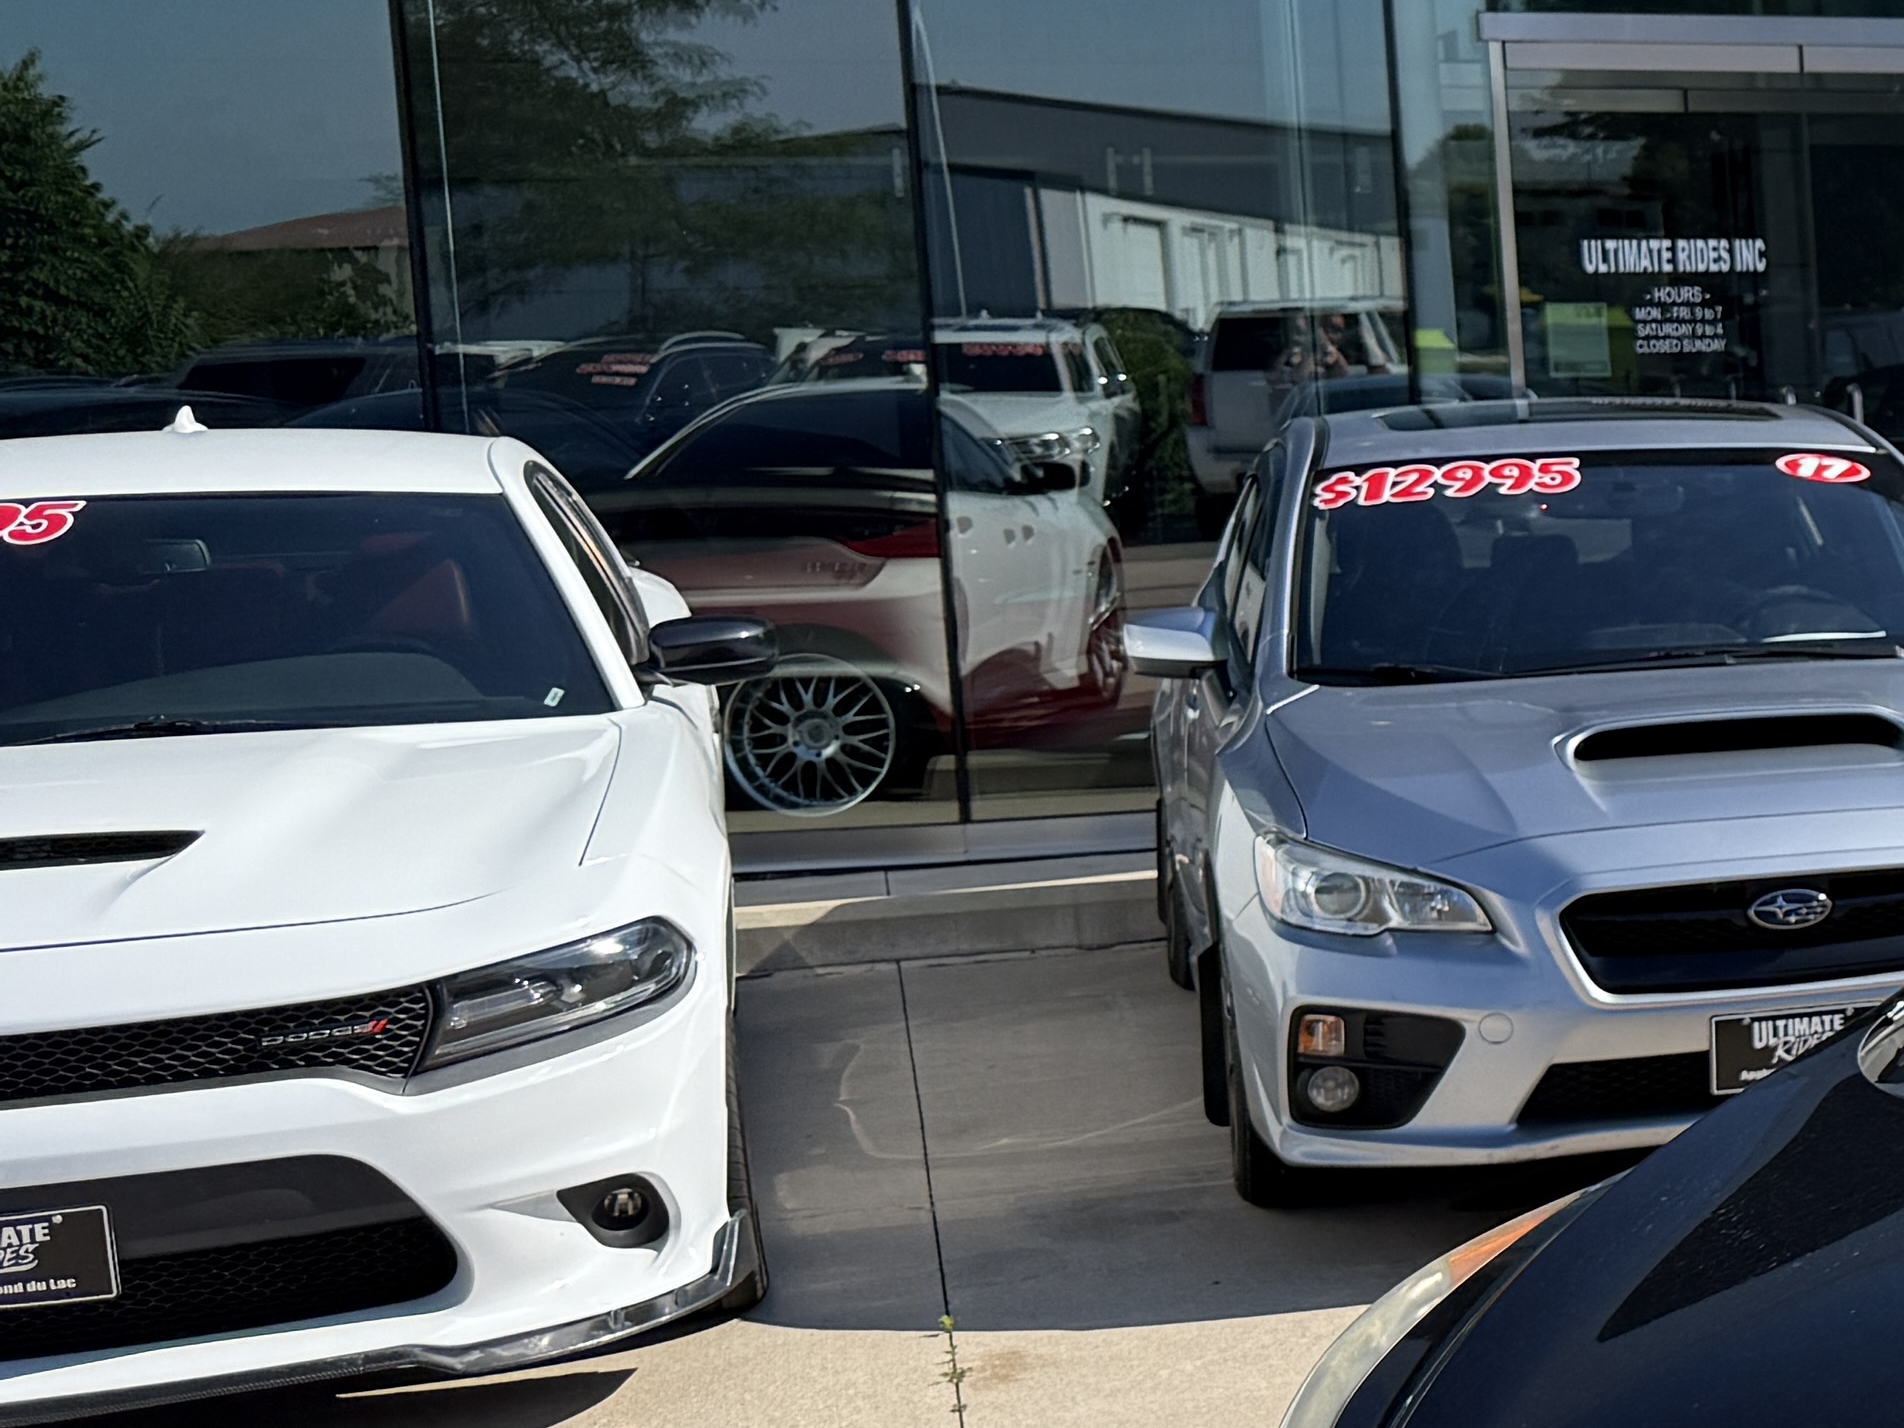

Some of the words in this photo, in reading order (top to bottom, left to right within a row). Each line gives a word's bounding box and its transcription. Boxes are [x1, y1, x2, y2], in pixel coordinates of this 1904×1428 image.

[1580, 238, 1674, 274] ULTIMATE
[1676, 238, 1731, 273] RIDES
[1733, 238, 1767, 273] INC
[1654, 286, 1703, 303] HOURS
[1637, 323, 1693, 337] SATURDAY
[1636, 339, 1680, 354] CLOSED
[1682, 339, 1727, 353] SUNDAY
[1795, 456, 1855, 480] 17
[1312, 456, 1582, 510] $12995
[1753, 1013, 1845, 1050] ULTIMATE
[26, 1280, 47, 1292] du
[49, 1278, 77, 1290] Lac
